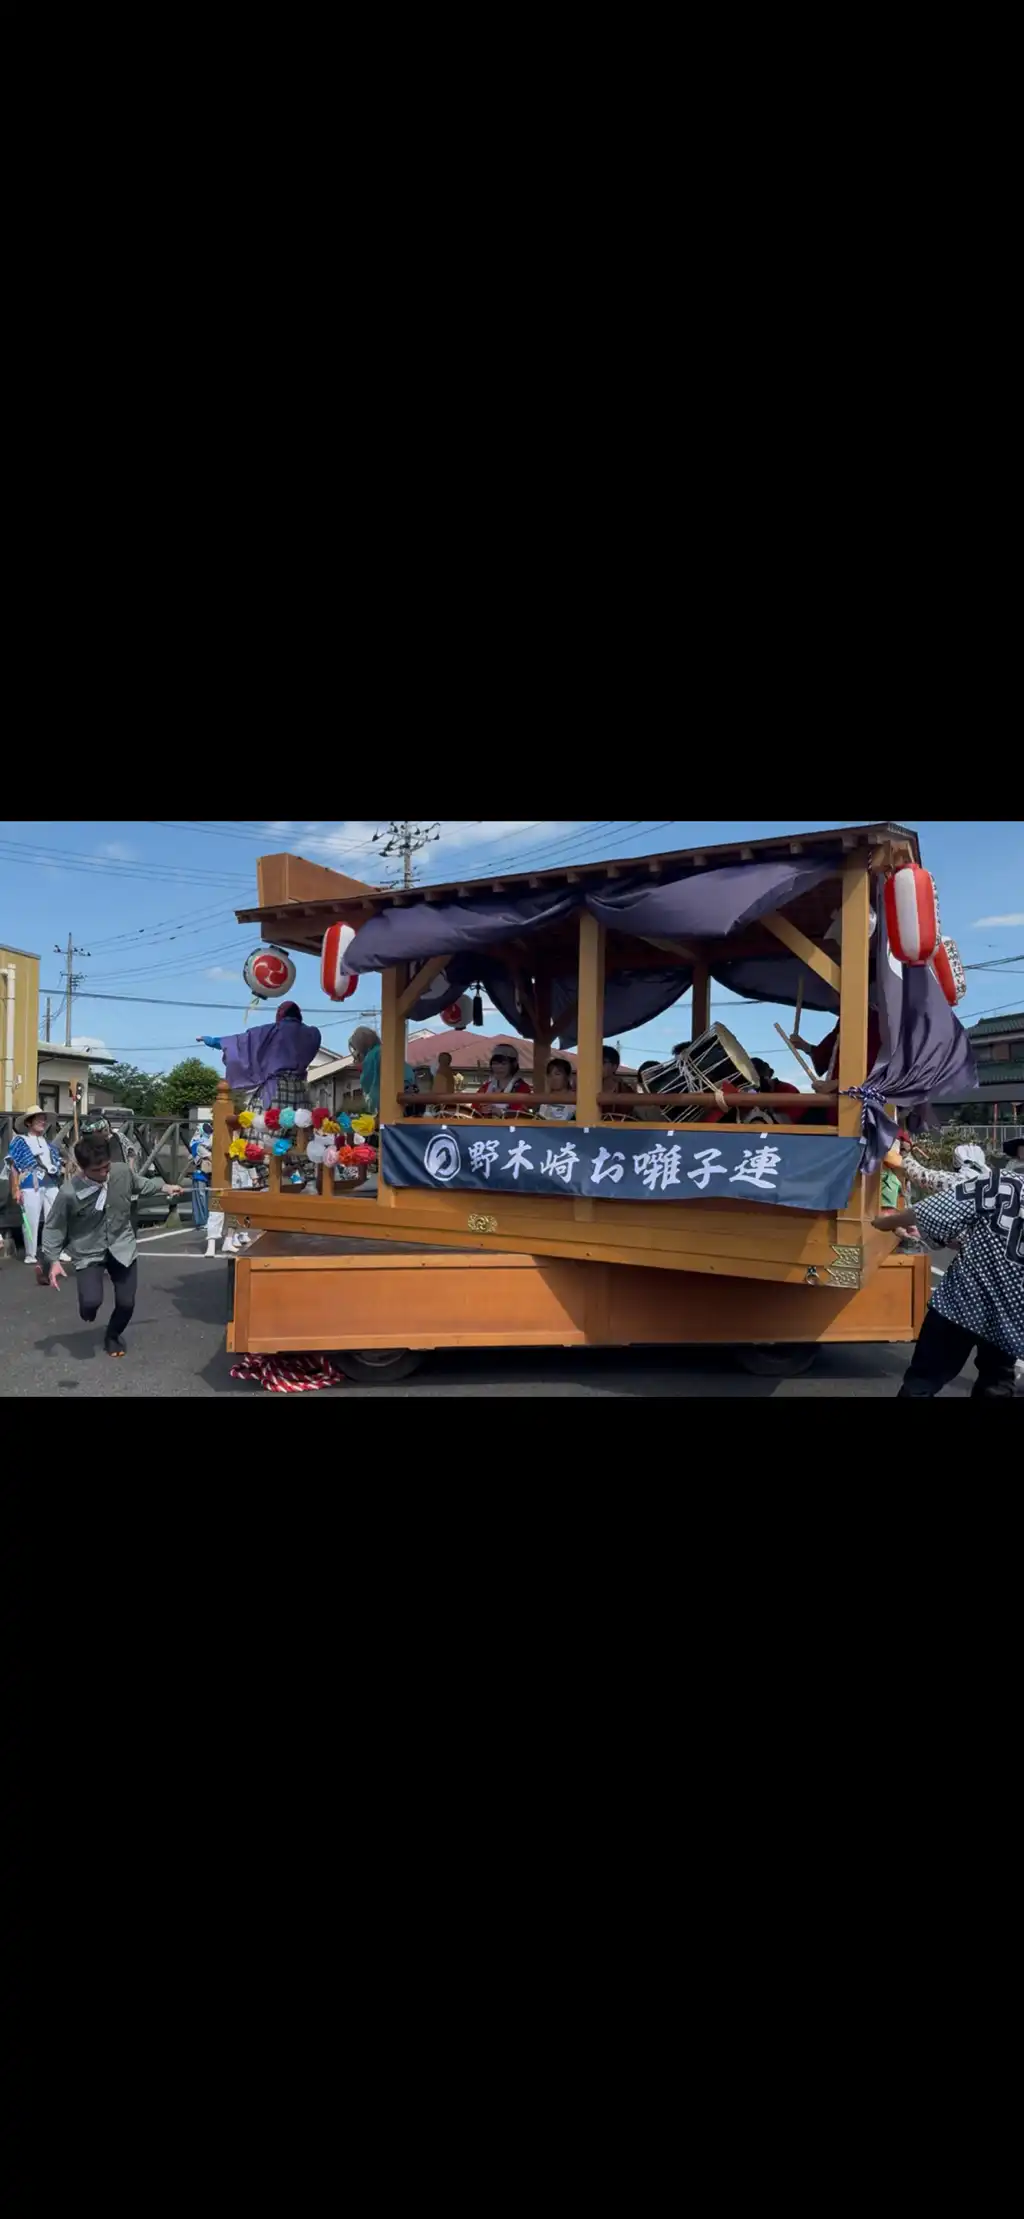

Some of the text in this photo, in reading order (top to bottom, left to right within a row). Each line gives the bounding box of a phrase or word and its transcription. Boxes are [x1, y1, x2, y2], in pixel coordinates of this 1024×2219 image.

[468, 1140, 782, 1191] 野木崎お囃子連
